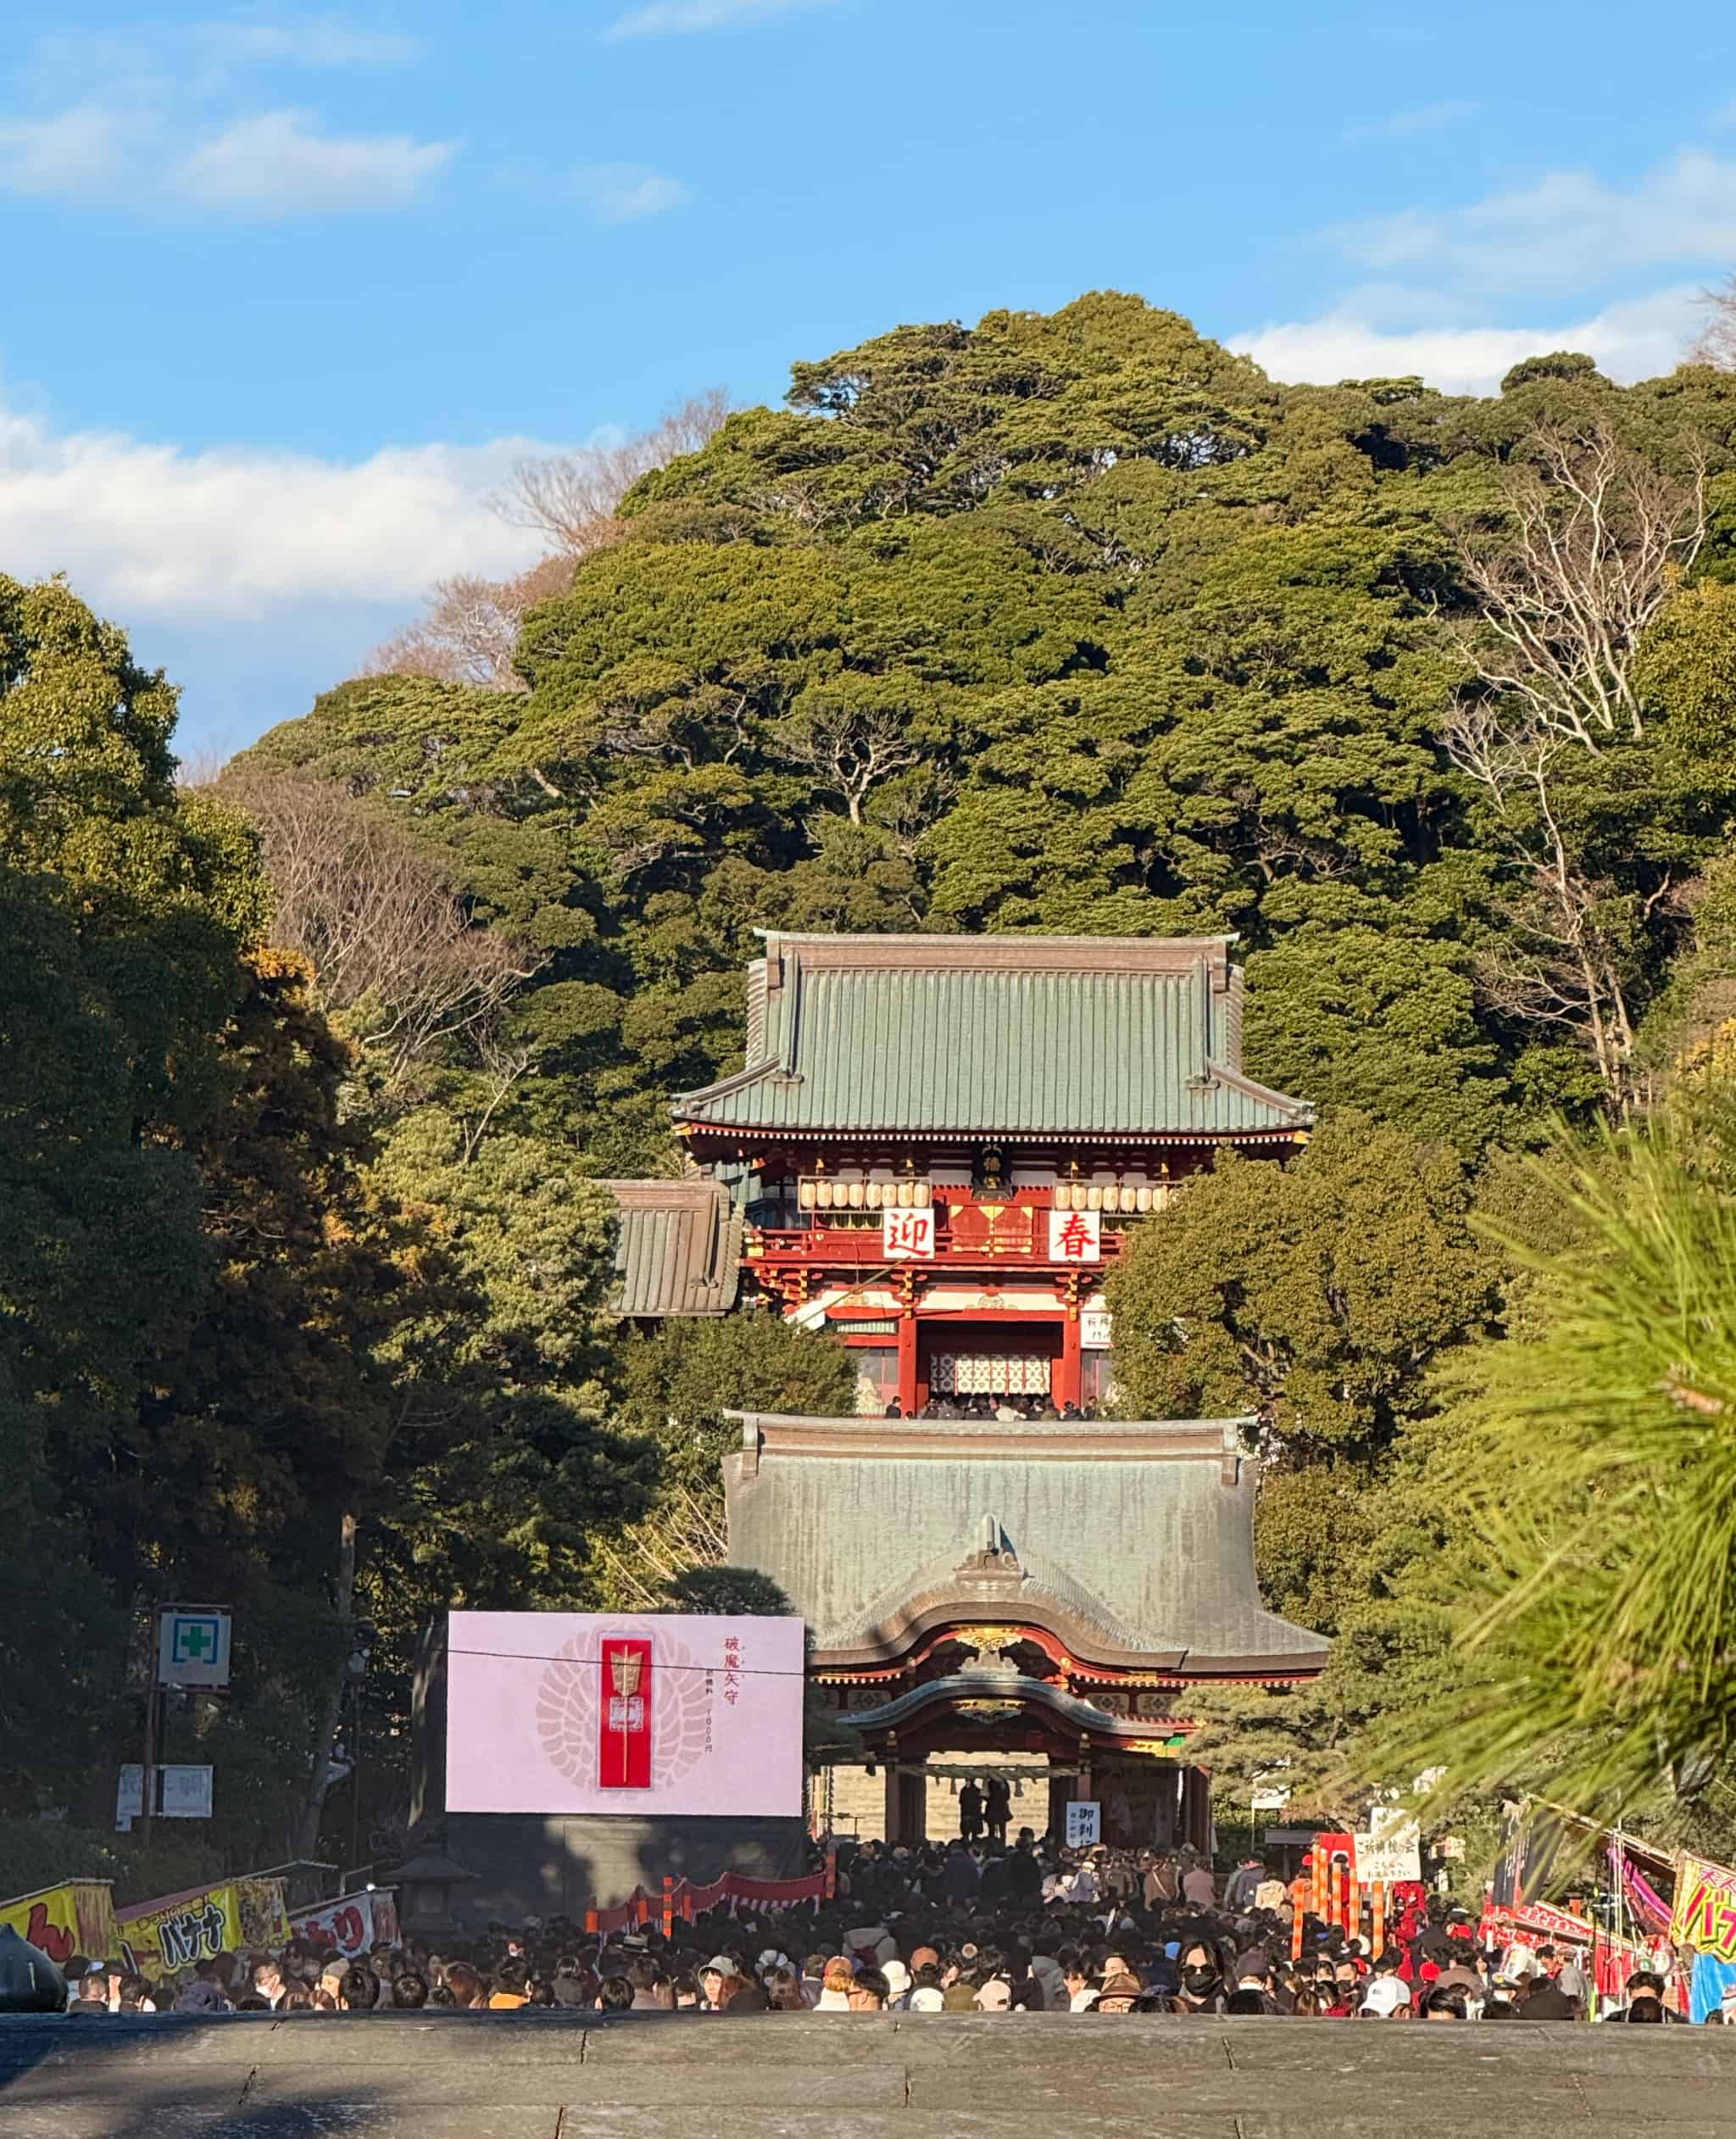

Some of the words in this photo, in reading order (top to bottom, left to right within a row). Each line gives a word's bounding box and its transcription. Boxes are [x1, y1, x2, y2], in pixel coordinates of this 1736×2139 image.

[887, 1212, 931, 1257] 迎
[1054, 1212, 1097, 1258] 春
[723, 1635, 741, 1707] 破魔矢守
[158, 1903, 225, 1969] バナナ
